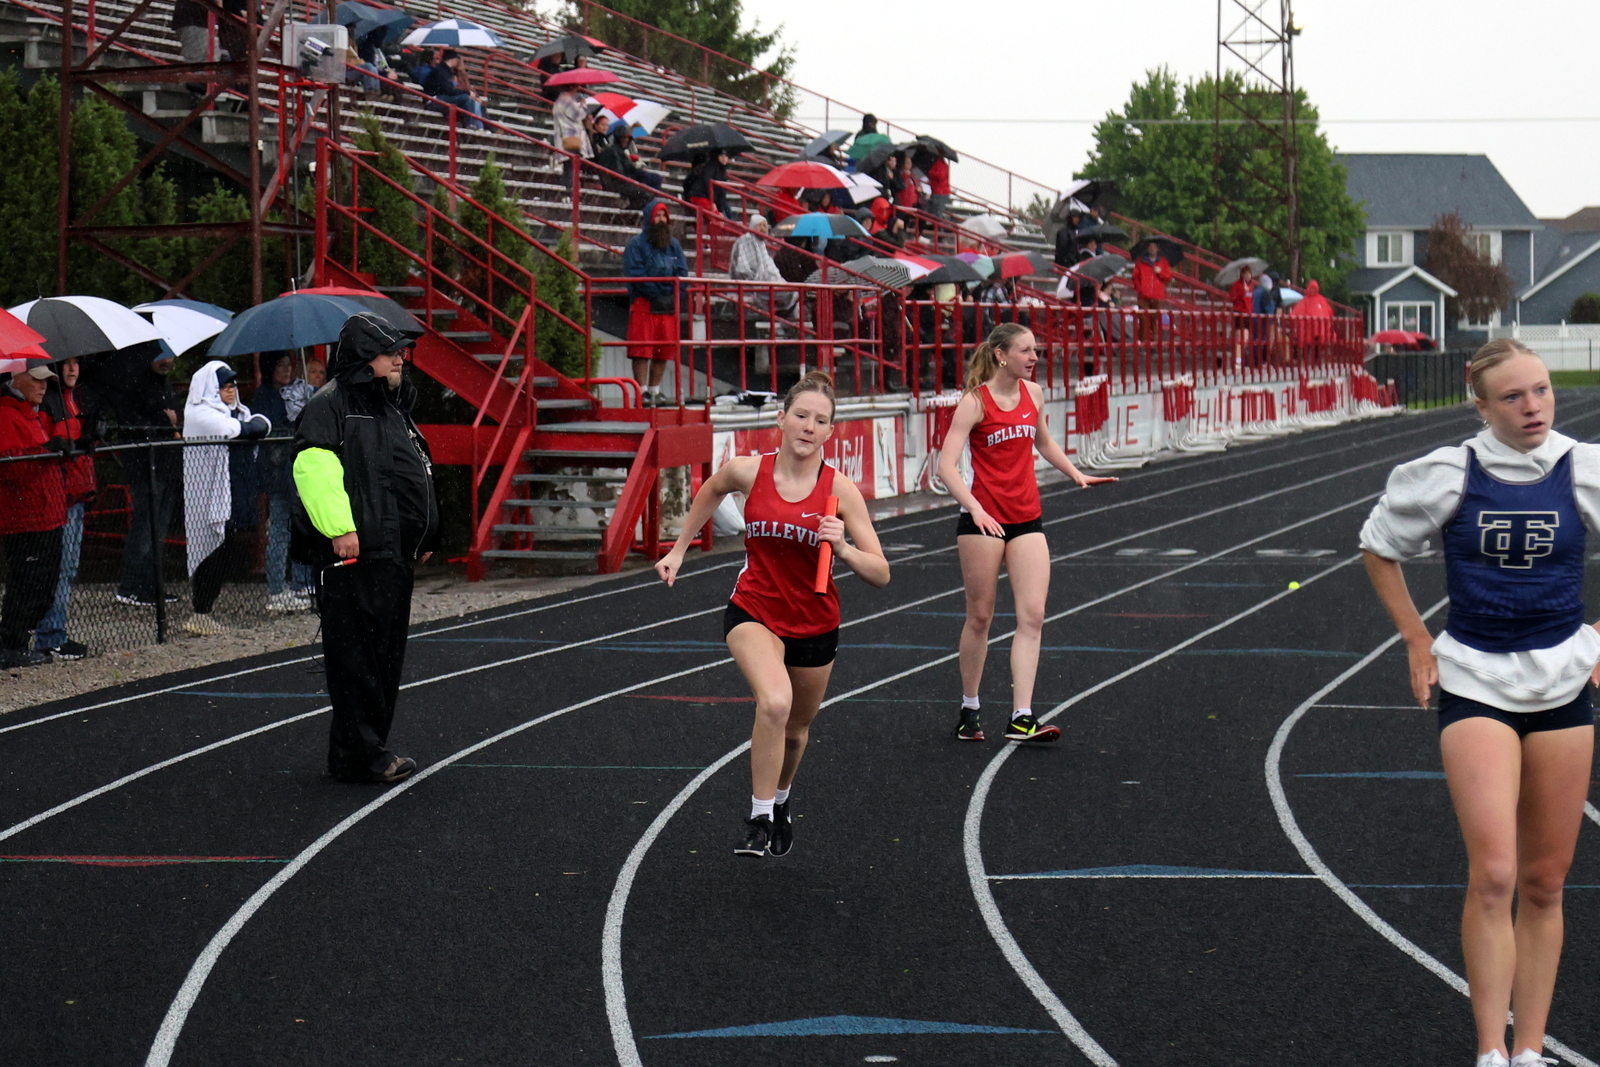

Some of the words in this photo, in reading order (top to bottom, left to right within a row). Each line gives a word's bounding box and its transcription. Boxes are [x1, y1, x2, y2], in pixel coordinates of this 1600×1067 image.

[987, 424, 1037, 447] BELLEVU
[842, 435, 864, 483] Field
[746, 520, 821, 549] BELLEVU
